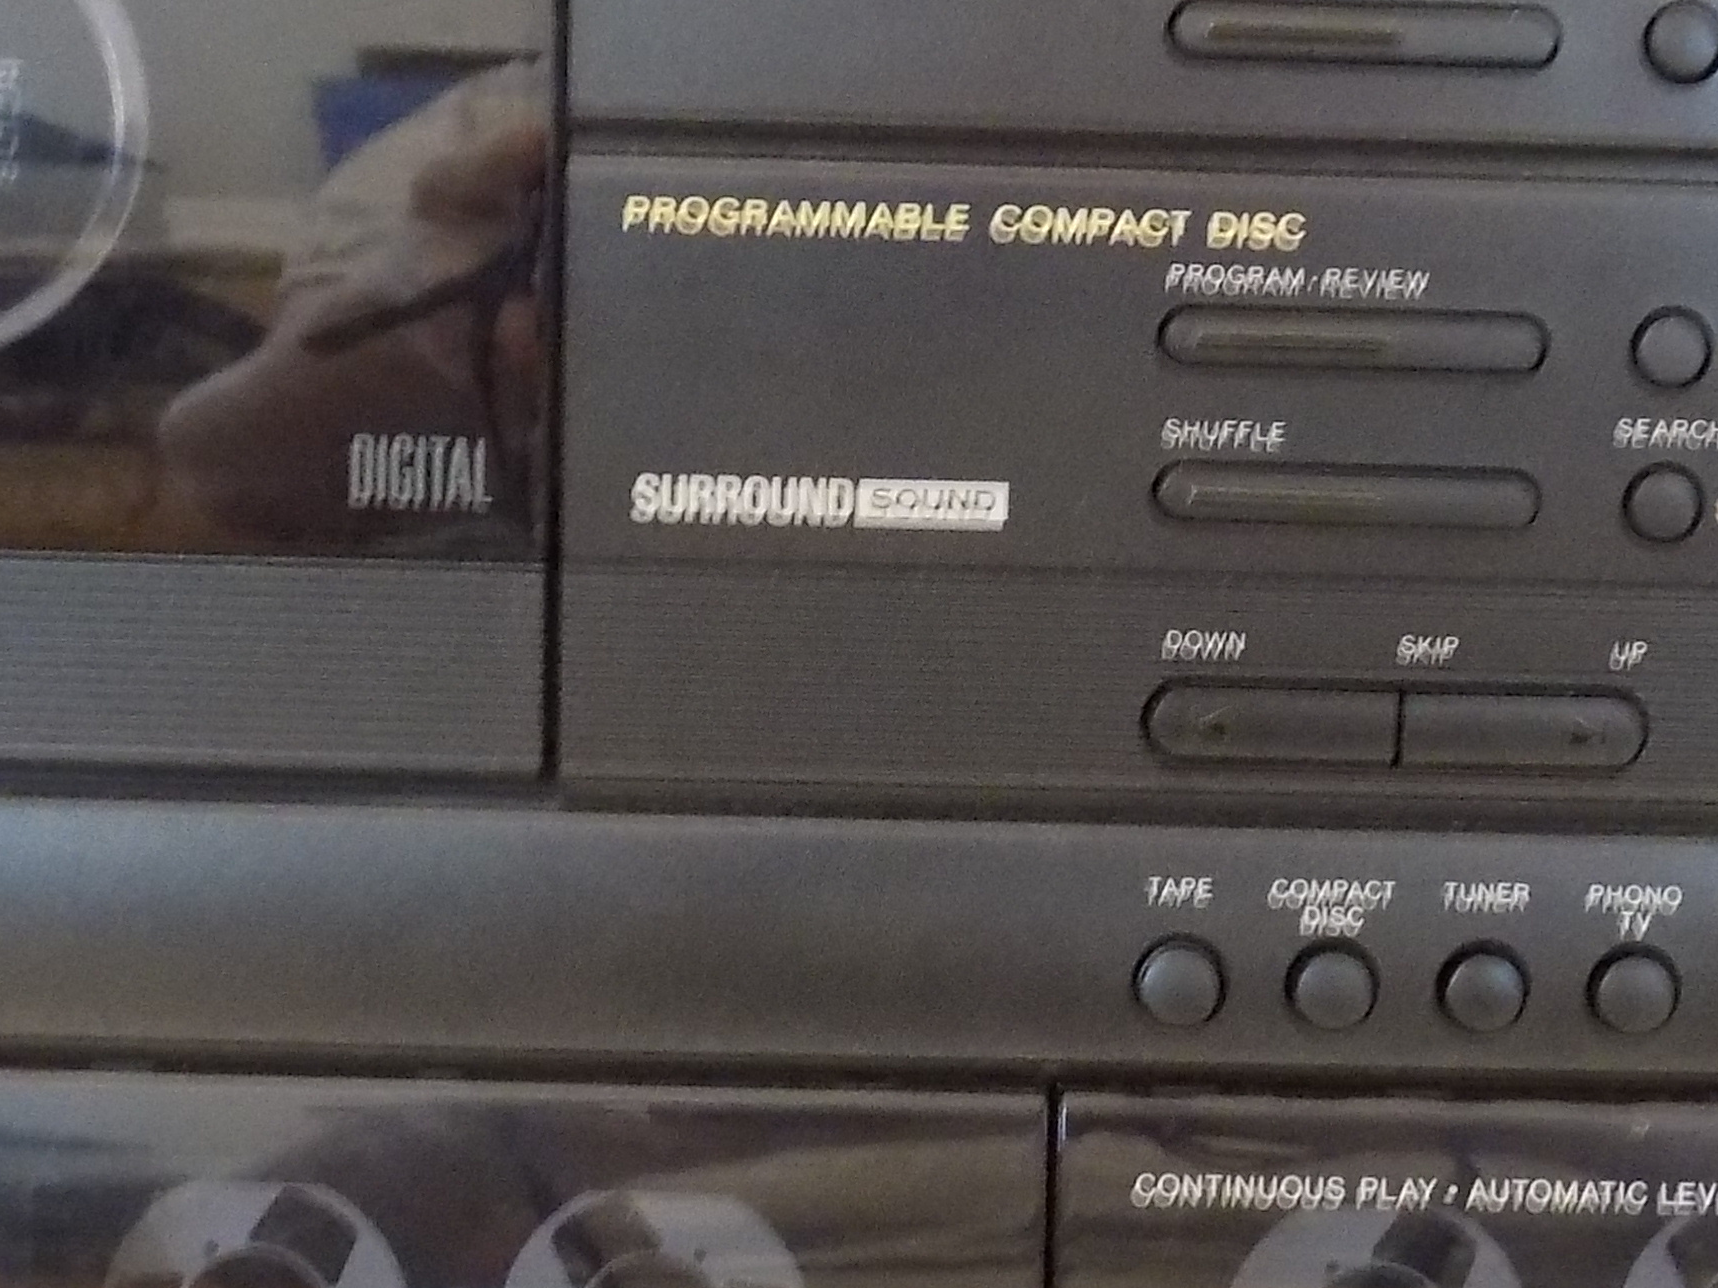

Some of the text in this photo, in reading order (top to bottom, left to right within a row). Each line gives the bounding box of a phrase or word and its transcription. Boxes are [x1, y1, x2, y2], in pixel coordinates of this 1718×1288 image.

[622, 194, 1308, 252] PROGRAMMABLE COMPACT DISC
[1161, 418, 1286, 453] SHUFFLE
[348, 432, 493, 512] DIGITAL
[630, 472, 999, 530] SURROUND SOUND
[1161, 629, 1247, 661] DOWN
[1396, 635, 1460, 666] SKIP
[1609, 640, 1648, 670] UP
[1145, 876, 1214, 910] TAPE
[1268, 879, 1397, 910] COMPACT
[1442, 882, 1531, 913] TUNER
[1584, 884, 1683, 914] PHONO
[1299, 907, 1365, 938] DISC
[1617, 912, 1653, 942] TV
[1131, 1172, 1347, 1211] CONTINUOUS
[1354, 1176, 1436, 1211] PLAY
[1464, 1178, 1649, 1216] AUTOMATIC
